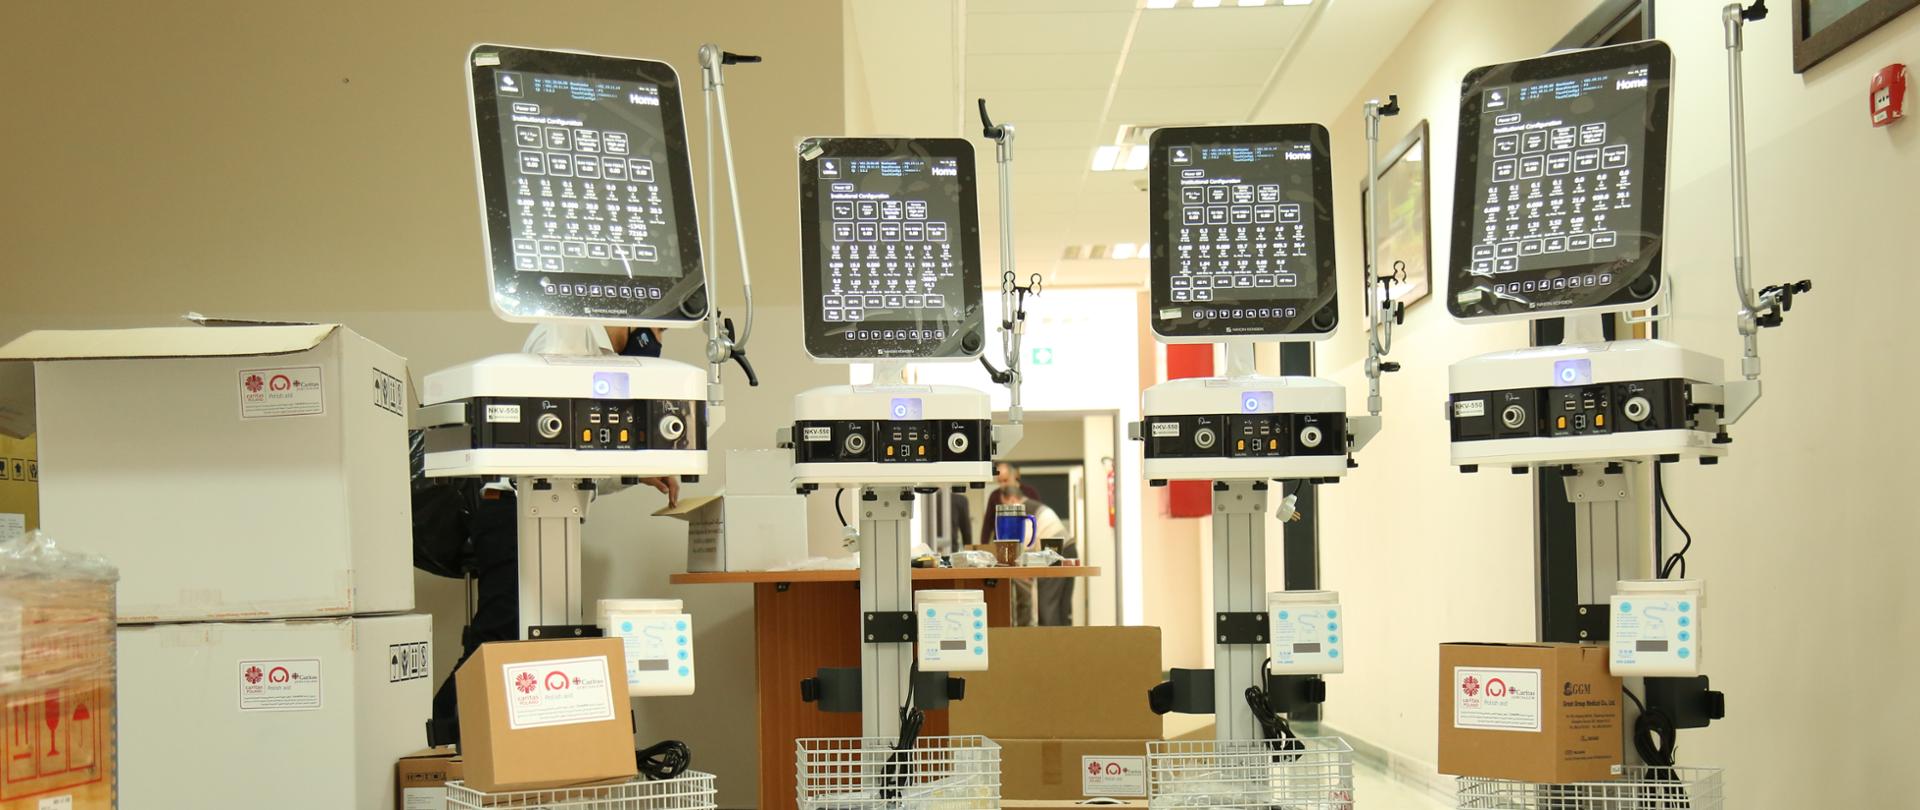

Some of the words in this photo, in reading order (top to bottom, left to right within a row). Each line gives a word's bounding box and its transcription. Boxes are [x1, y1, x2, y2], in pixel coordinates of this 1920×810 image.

[1616, 76, 1647, 90] Home
[629, 93, 659, 106] Home
[512, 114, 545, 123] Institutional
[546, 118, 583, 127] Configuration
[1493, 124, 1524, 134] Institutional
[1525, 119, 1562, 130] Configuration
[1284, 151, 1311, 160] Home
[931, 167, 956, 176] Home
[1572, 683, 1591, 695] GGM
